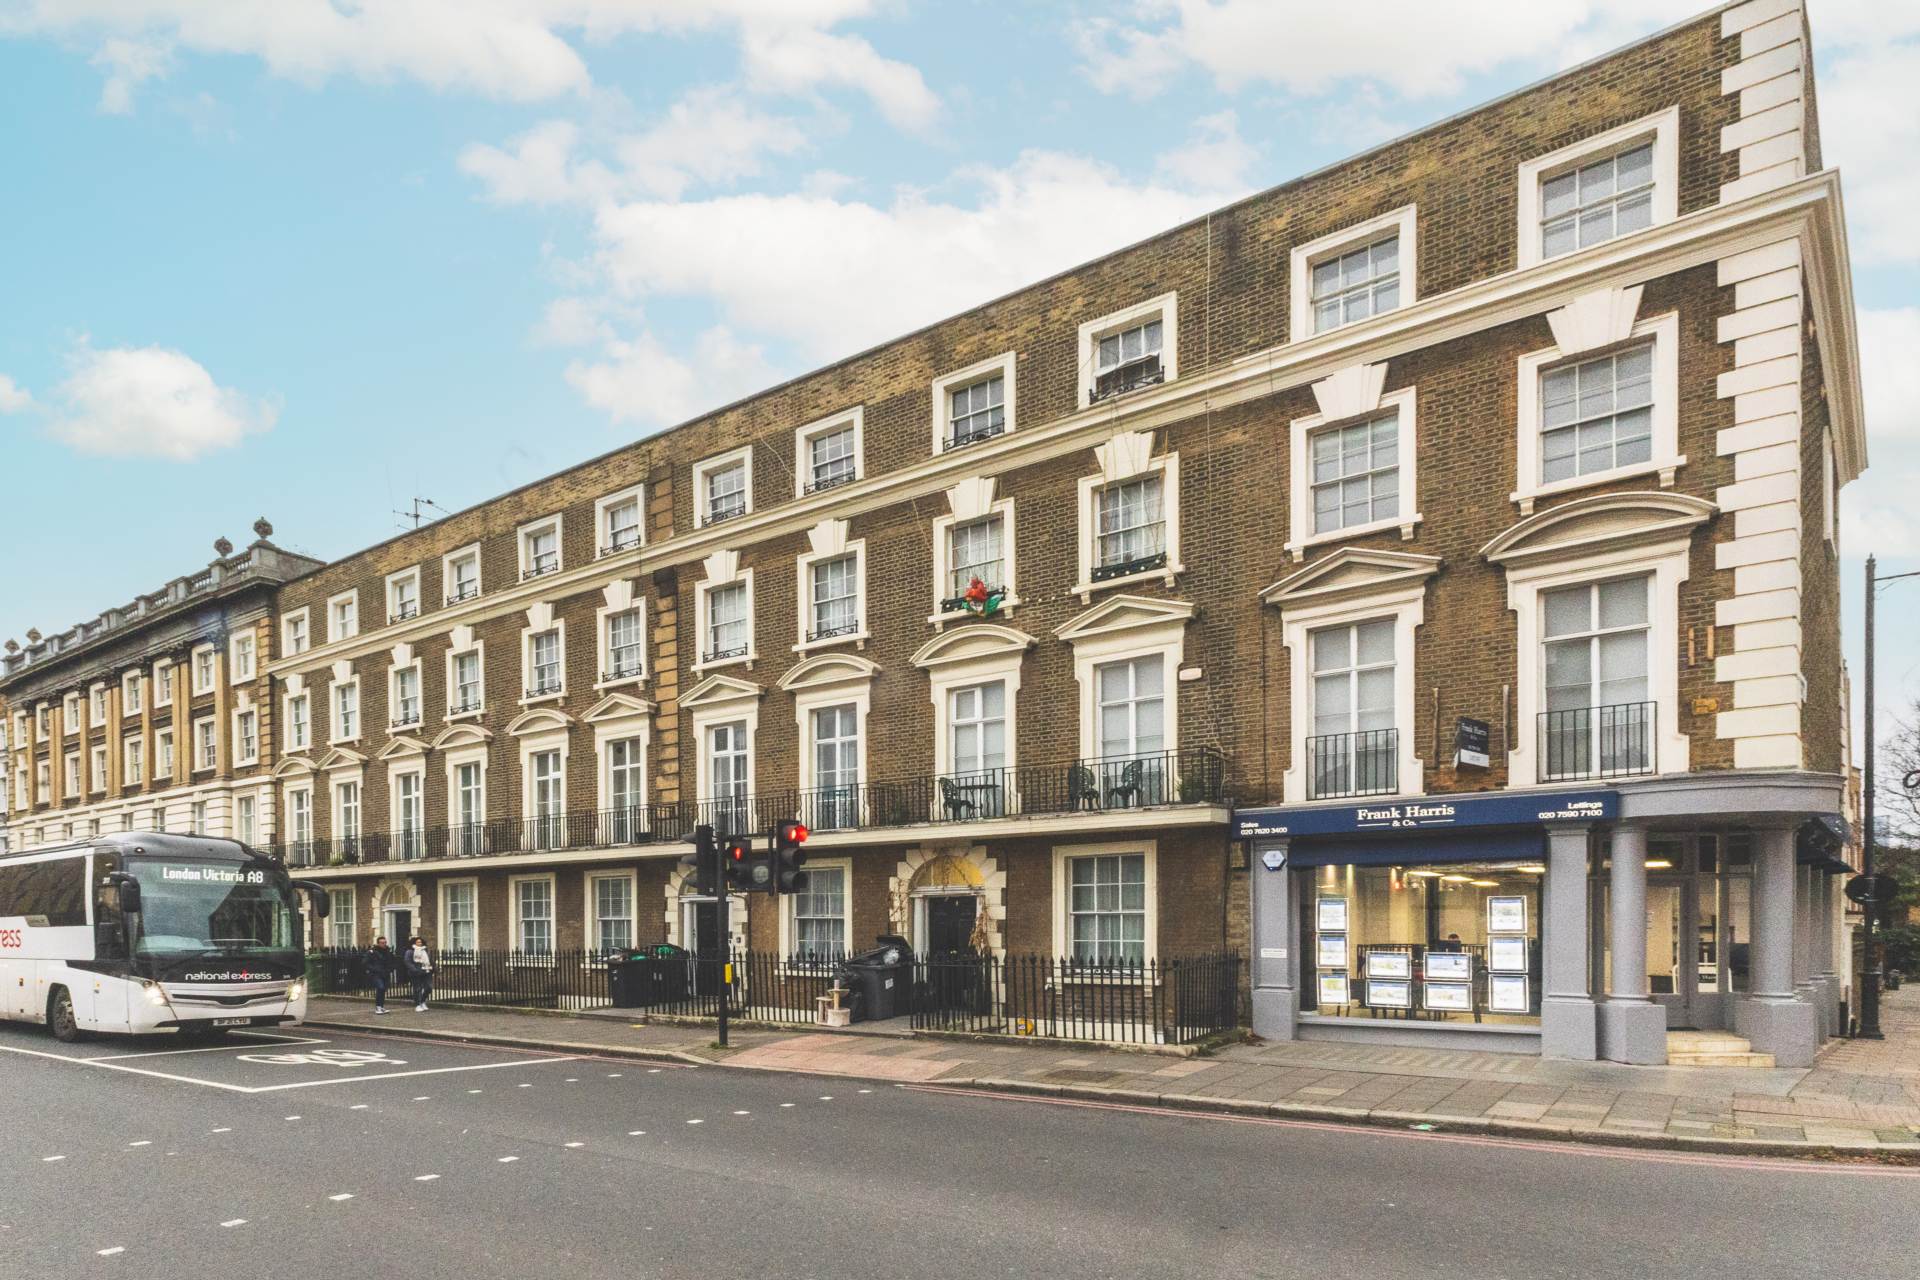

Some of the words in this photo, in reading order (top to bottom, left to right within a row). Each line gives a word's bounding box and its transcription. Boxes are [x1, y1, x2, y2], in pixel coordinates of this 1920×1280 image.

[1357, 807, 1401, 820] Frank
[1405, 804, 1455, 818] Harris
[1538, 811, 1556, 819] 020
[1580, 809, 1603, 817] 7100
[163, 867, 201, 880] London
[203, 869, 244, 882] Victoria
[247, 870, 264, 884] A8
[185, 971, 230, 981] national
[231, 969, 272, 981] express
